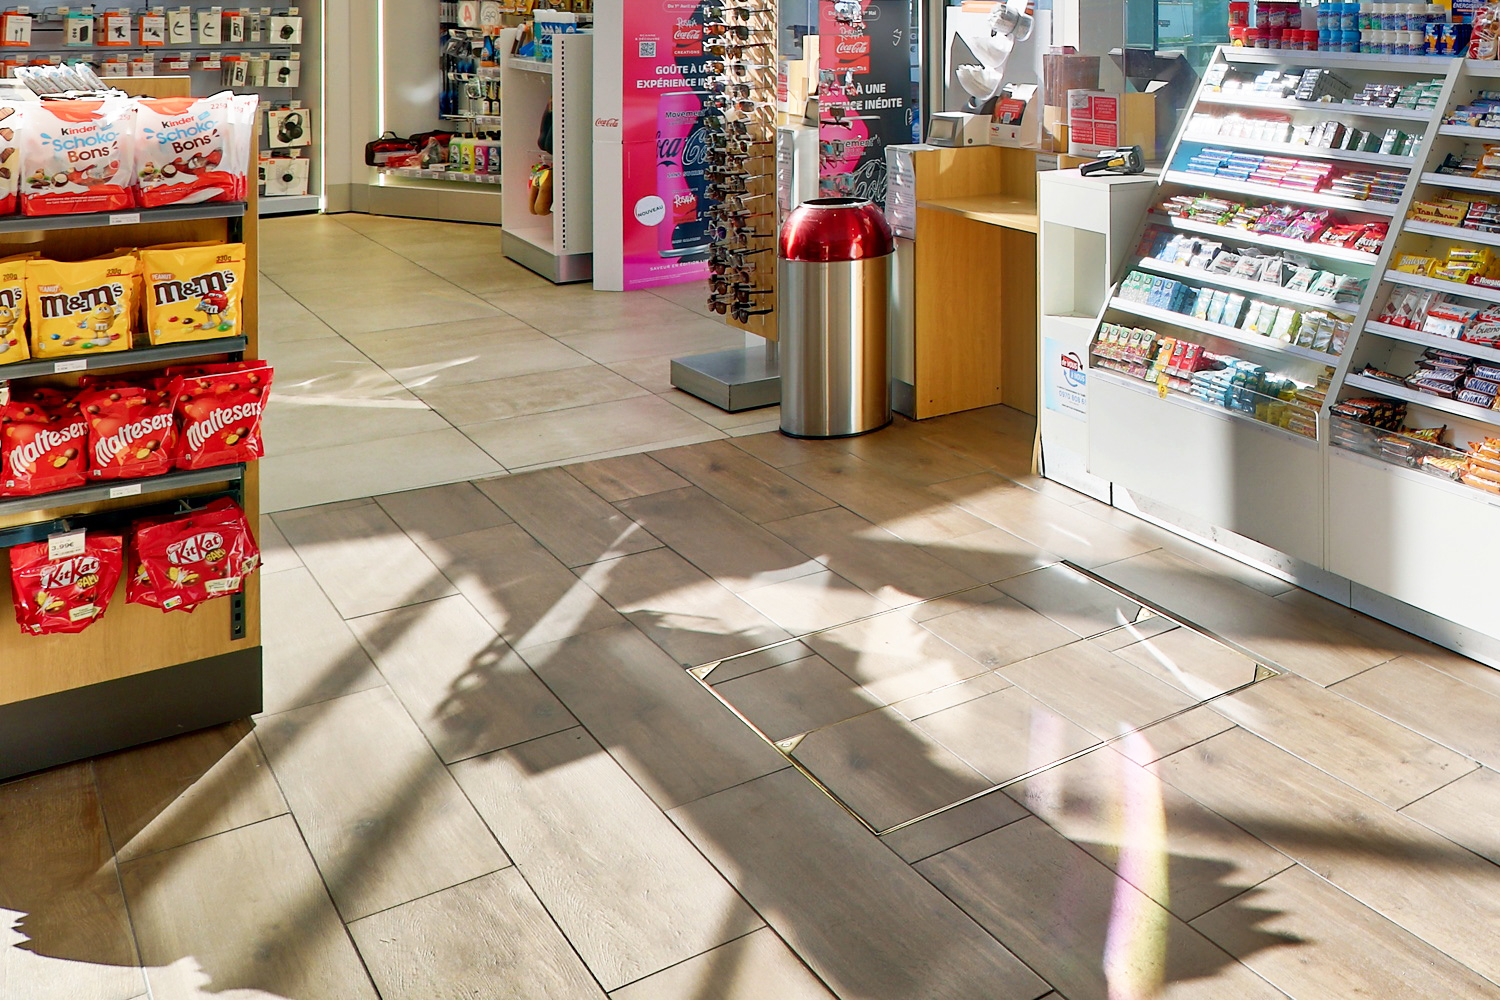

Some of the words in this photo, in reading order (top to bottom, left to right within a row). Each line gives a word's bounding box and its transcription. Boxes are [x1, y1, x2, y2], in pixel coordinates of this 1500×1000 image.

[656, 64, 688, 74] GOÛTE
[690, 64, 698, 74] À
[636, 78, 696, 88] EXPÉRIENCE
[866, 84, 886, 94] UNE
[865, 97, 902, 110] INÉDITE
[156, 118, 220, 146] Schoko-
[53, 128, 120, 154] Schoko-
[172, 134, 212, 156] Bons
[68, 145, 110, 164] Bons
[638, 205, 664, 218] NOUVEAU
[216, 254, 232, 262] 330g
[1476, 324, 1500, 336] bueno
[1467, 378, 1498, 394] SNICKER
[186, 401, 262, 452] Maltesers
[96, 412, 174, 468] Maltesers
[9, 421, 89, 478] Maltesers
[51, 542, 74, 552] 3.99€
[176, 533, 222, 564] KitKat
